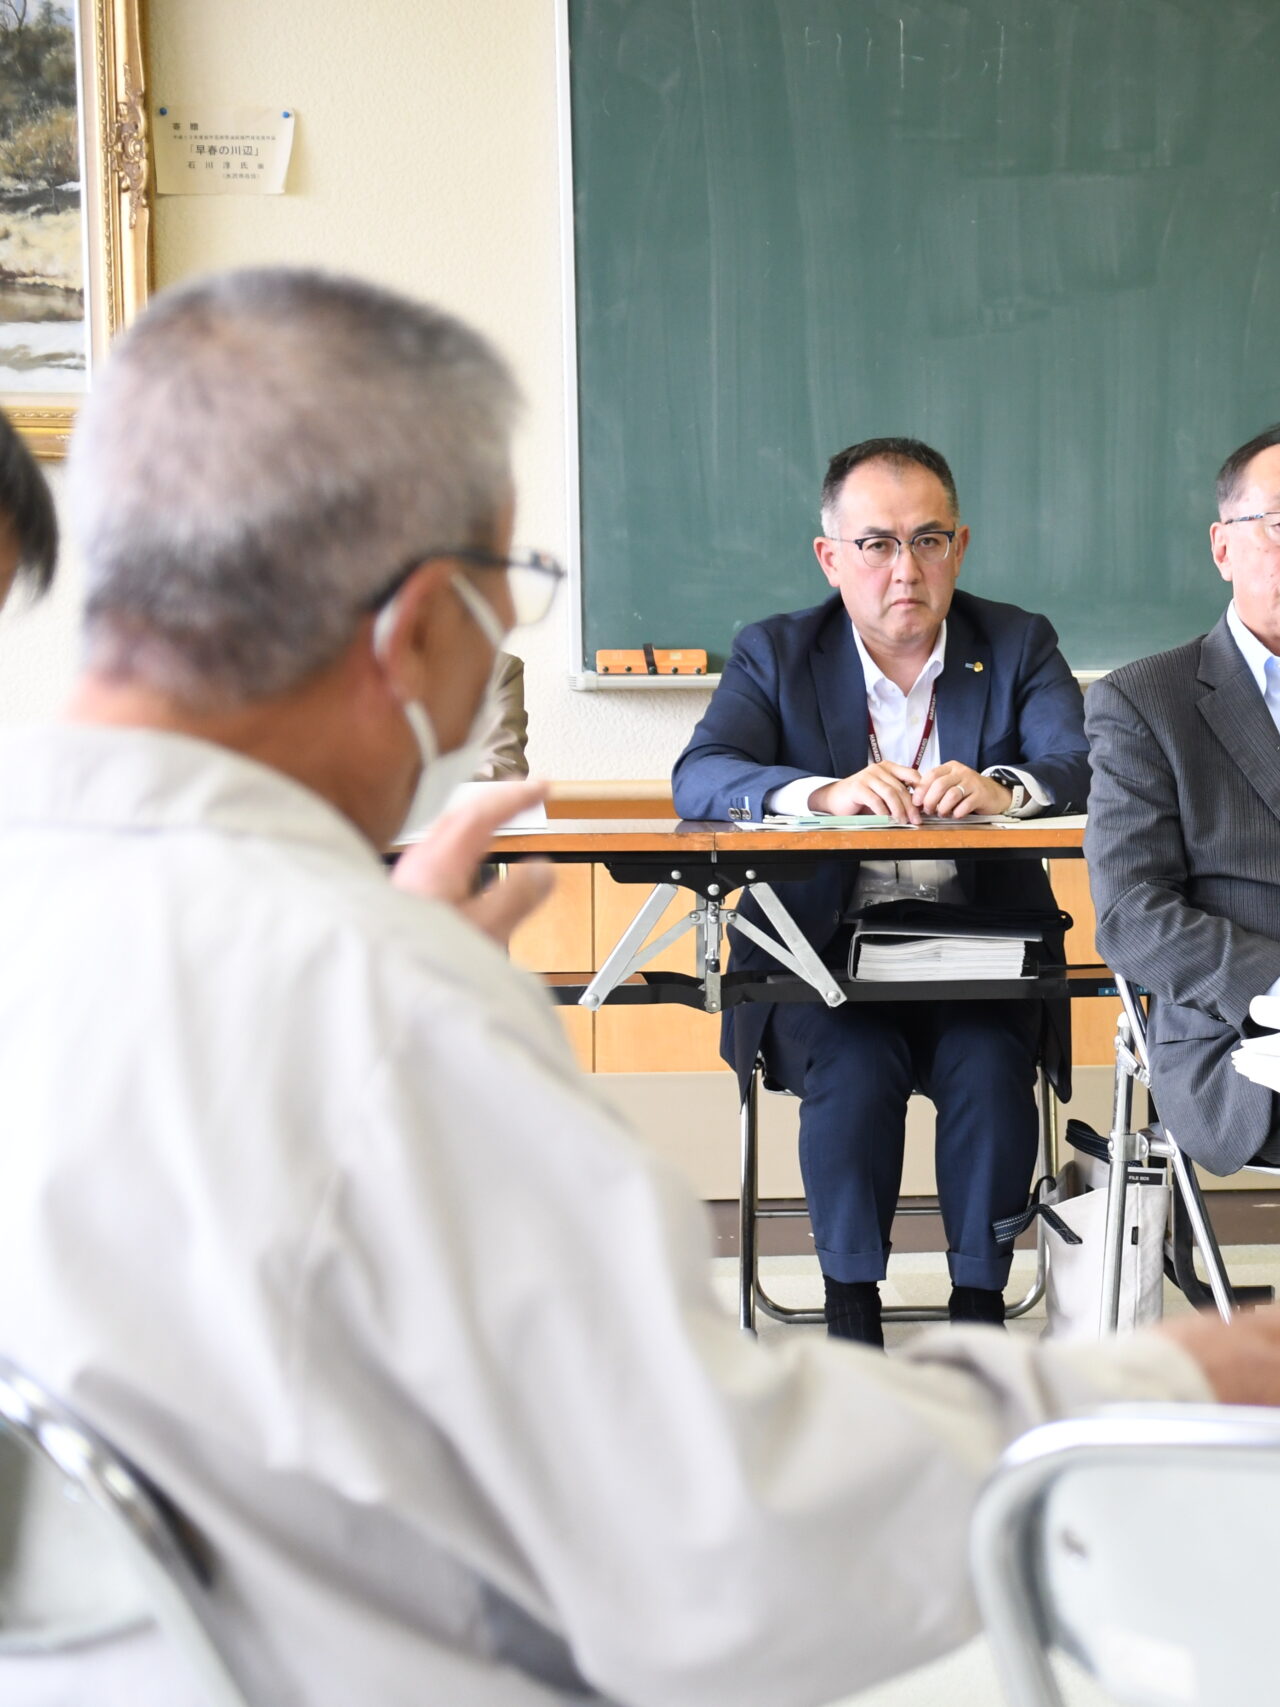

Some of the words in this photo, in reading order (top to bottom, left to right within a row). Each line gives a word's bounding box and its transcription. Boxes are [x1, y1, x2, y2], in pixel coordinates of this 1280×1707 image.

[190, 144, 259, 156] 「早春の川辺」
[869, 733, 881, 763] HARVARD
